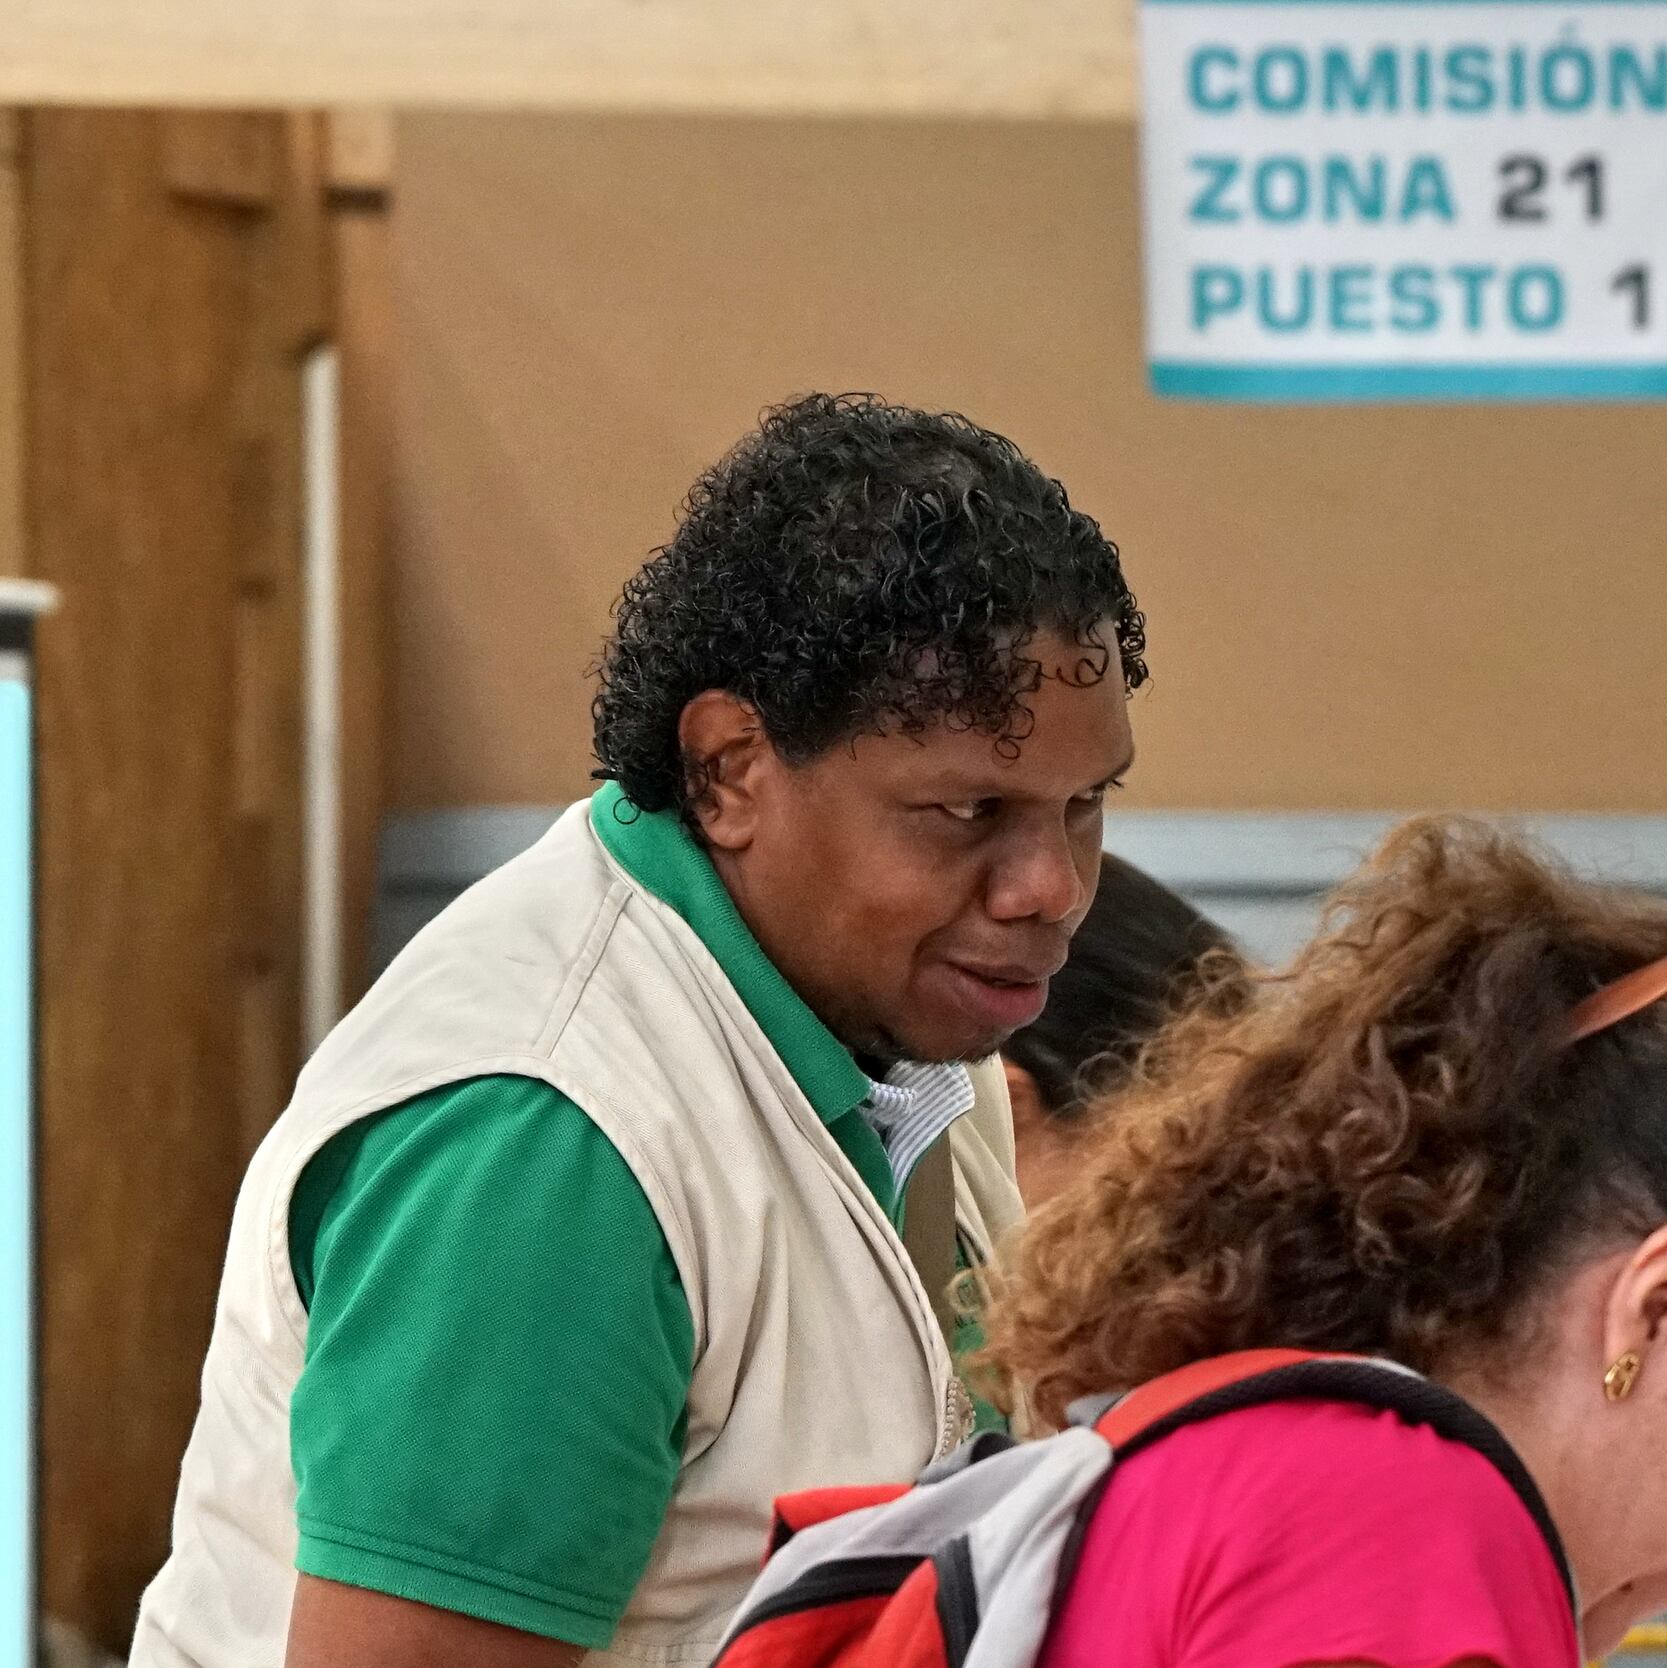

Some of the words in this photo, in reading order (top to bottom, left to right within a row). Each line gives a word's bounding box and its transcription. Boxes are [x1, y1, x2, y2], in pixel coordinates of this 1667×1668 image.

[1186, 153, 1458, 226] ZONA
[1495, 153, 1607, 225] 21
[1188, 262, 1568, 336] PUESTO
[1609, 261, 1652, 331] 1
